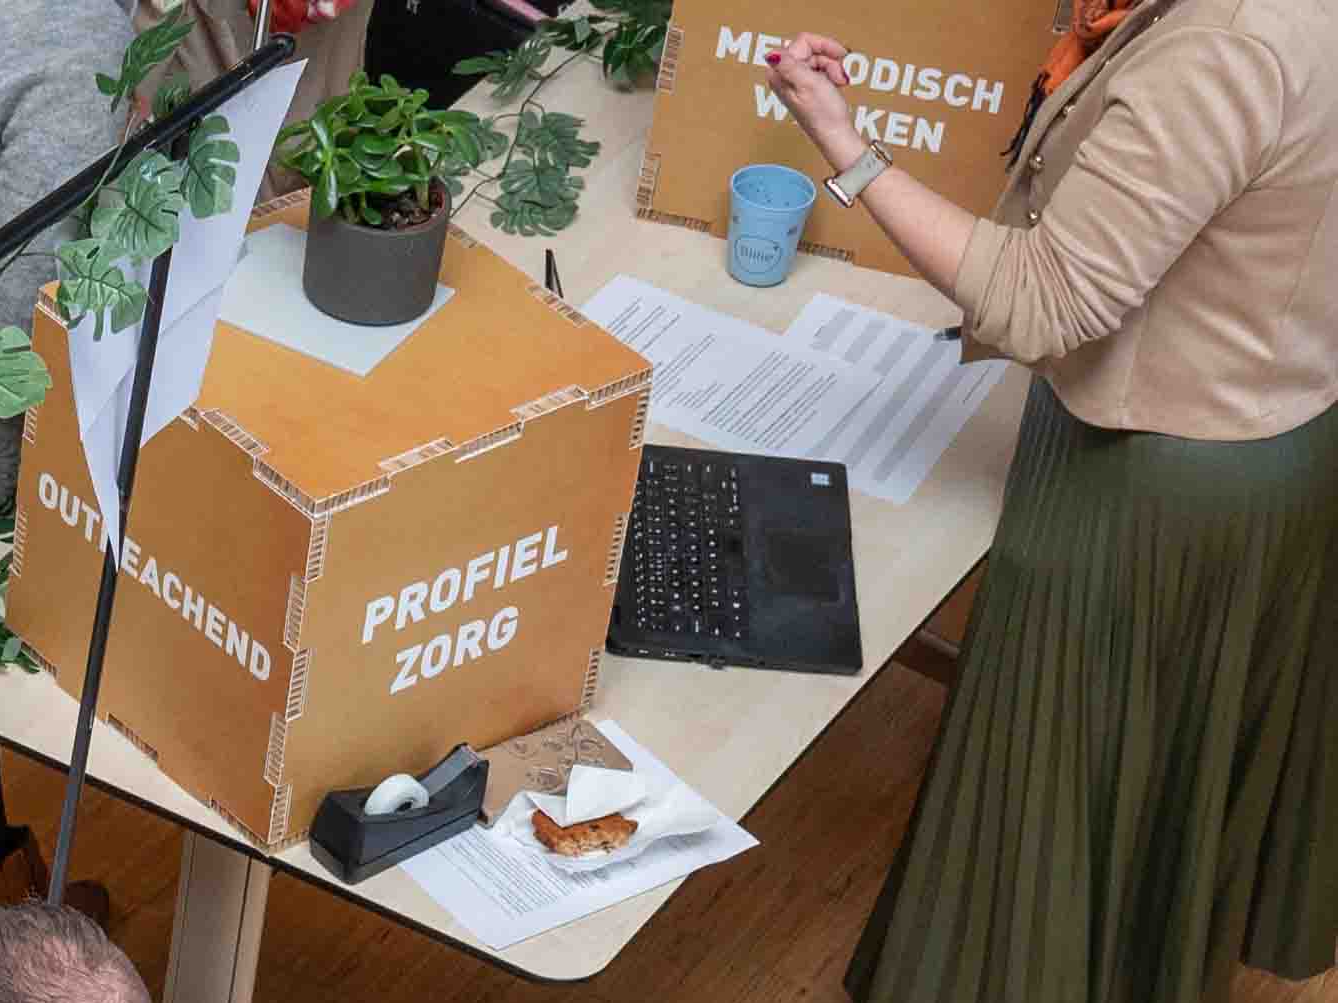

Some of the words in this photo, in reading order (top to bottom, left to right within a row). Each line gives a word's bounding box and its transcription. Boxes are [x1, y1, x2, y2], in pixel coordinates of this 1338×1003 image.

[715, 25, 1005, 114] MEODISCH
[754, 84, 945, 153] WKEN
[362, 525, 568, 645] PROFIEL
[390, 606, 520, 695] ZORG
